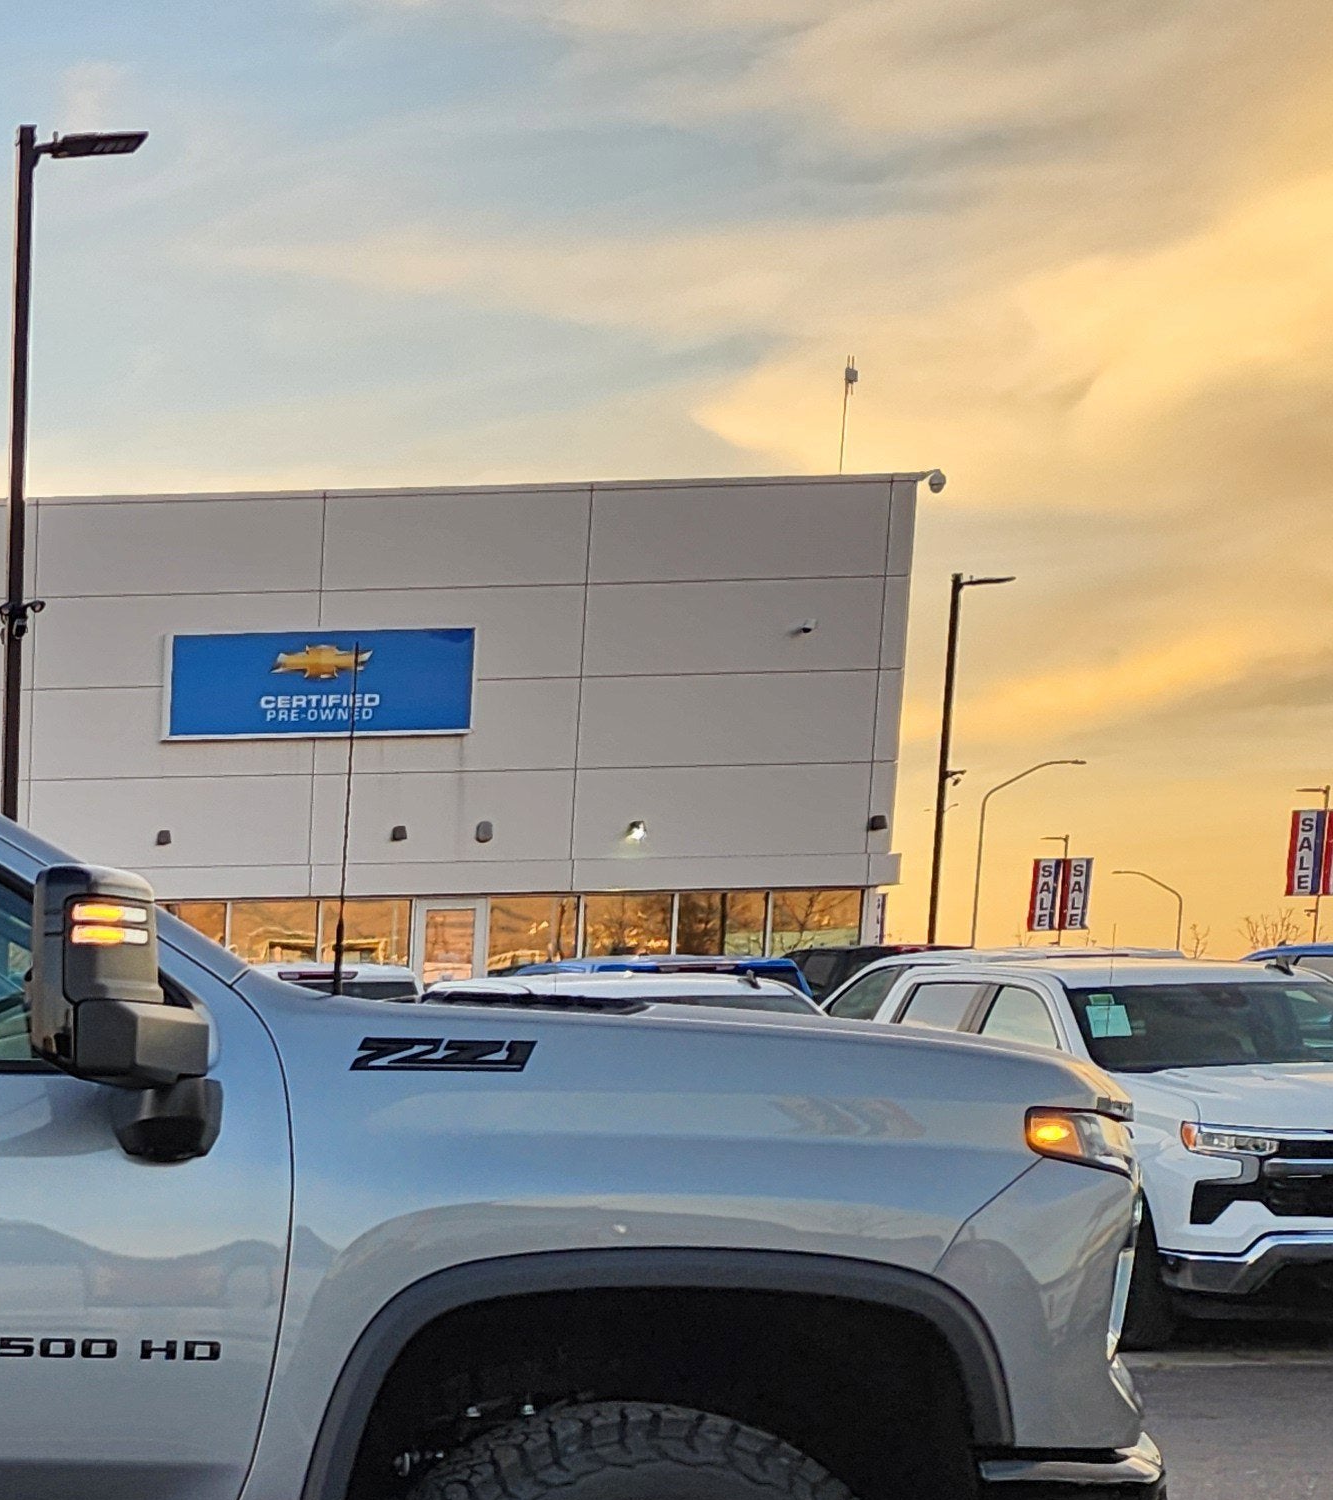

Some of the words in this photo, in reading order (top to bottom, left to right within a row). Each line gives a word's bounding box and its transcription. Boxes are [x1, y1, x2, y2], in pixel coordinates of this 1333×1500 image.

[260, 693, 381, 709] CERTIFIED
[265, 708, 373, 722] PRE-OWNED
[1296, 817, 1314, 890] SALE
[1036, 864, 1053, 927] SALE
[1067, 864, 1084, 927] SALE
[349, 1037, 538, 1073] Z71
[140, 1340, 221, 1361] HD
